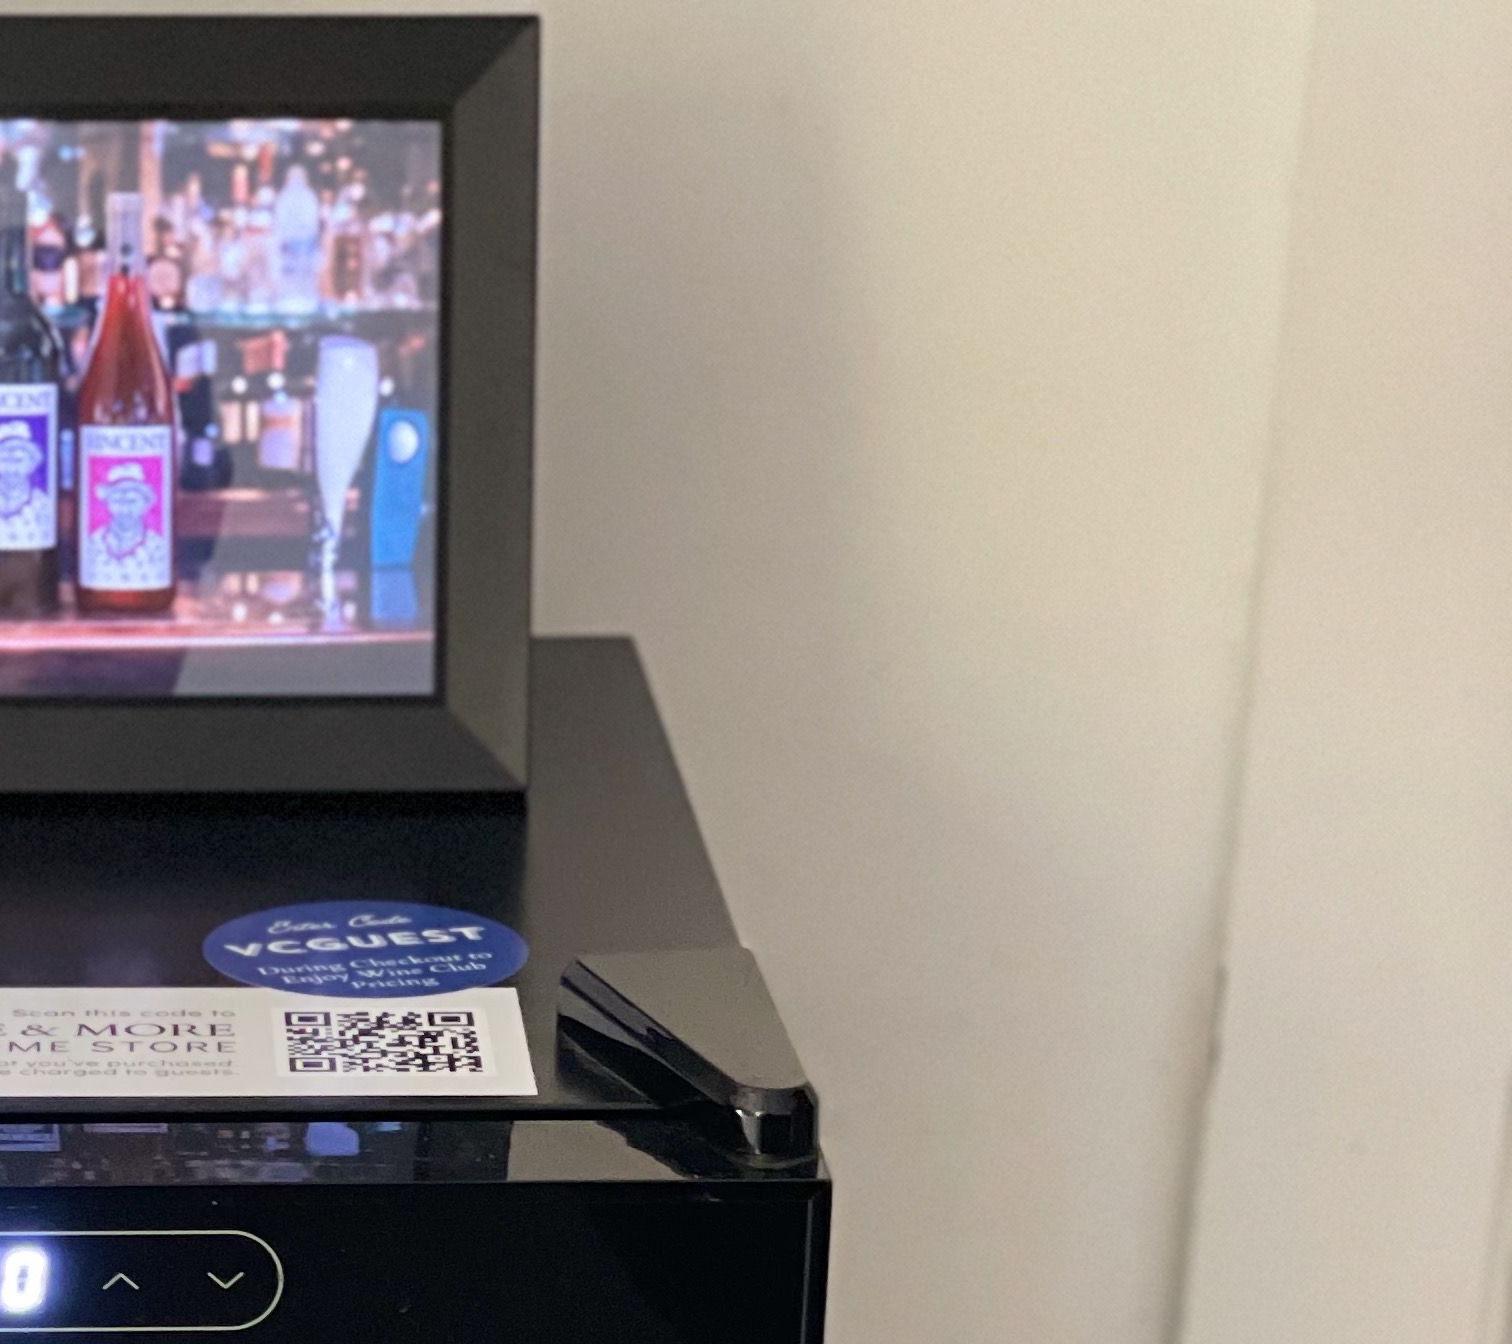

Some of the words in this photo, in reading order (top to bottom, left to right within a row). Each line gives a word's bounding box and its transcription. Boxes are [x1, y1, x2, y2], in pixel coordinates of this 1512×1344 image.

[267, 919, 336, 935] Enter
[347, 914, 412, 929] Code
[224, 926, 486, 958] VCGUEST
[256, 962, 347, 976] During
[349, 952, 462, 970] Checkout
[468, 951, 493, 961] to
[281, 970, 349, 985] Enjoy
[356, 967, 423, 979] Wine
[429, 961, 487, 974] Club
[351, 976, 441, 990] Pricing
[11, 1008, 76, 1018] Scan
[85, 1008, 131, 1018] this
[140, 1008, 203, 1018] code
[212, 1008, 236, 1018] to
[20, 1024, 61, 1038] &
[75, 1022, 236, 1038] MORE
[90, 1040, 237, 1054] STORE
[19, 1068, 118, 1078] charged
[125, 1068, 148, 1077] to
